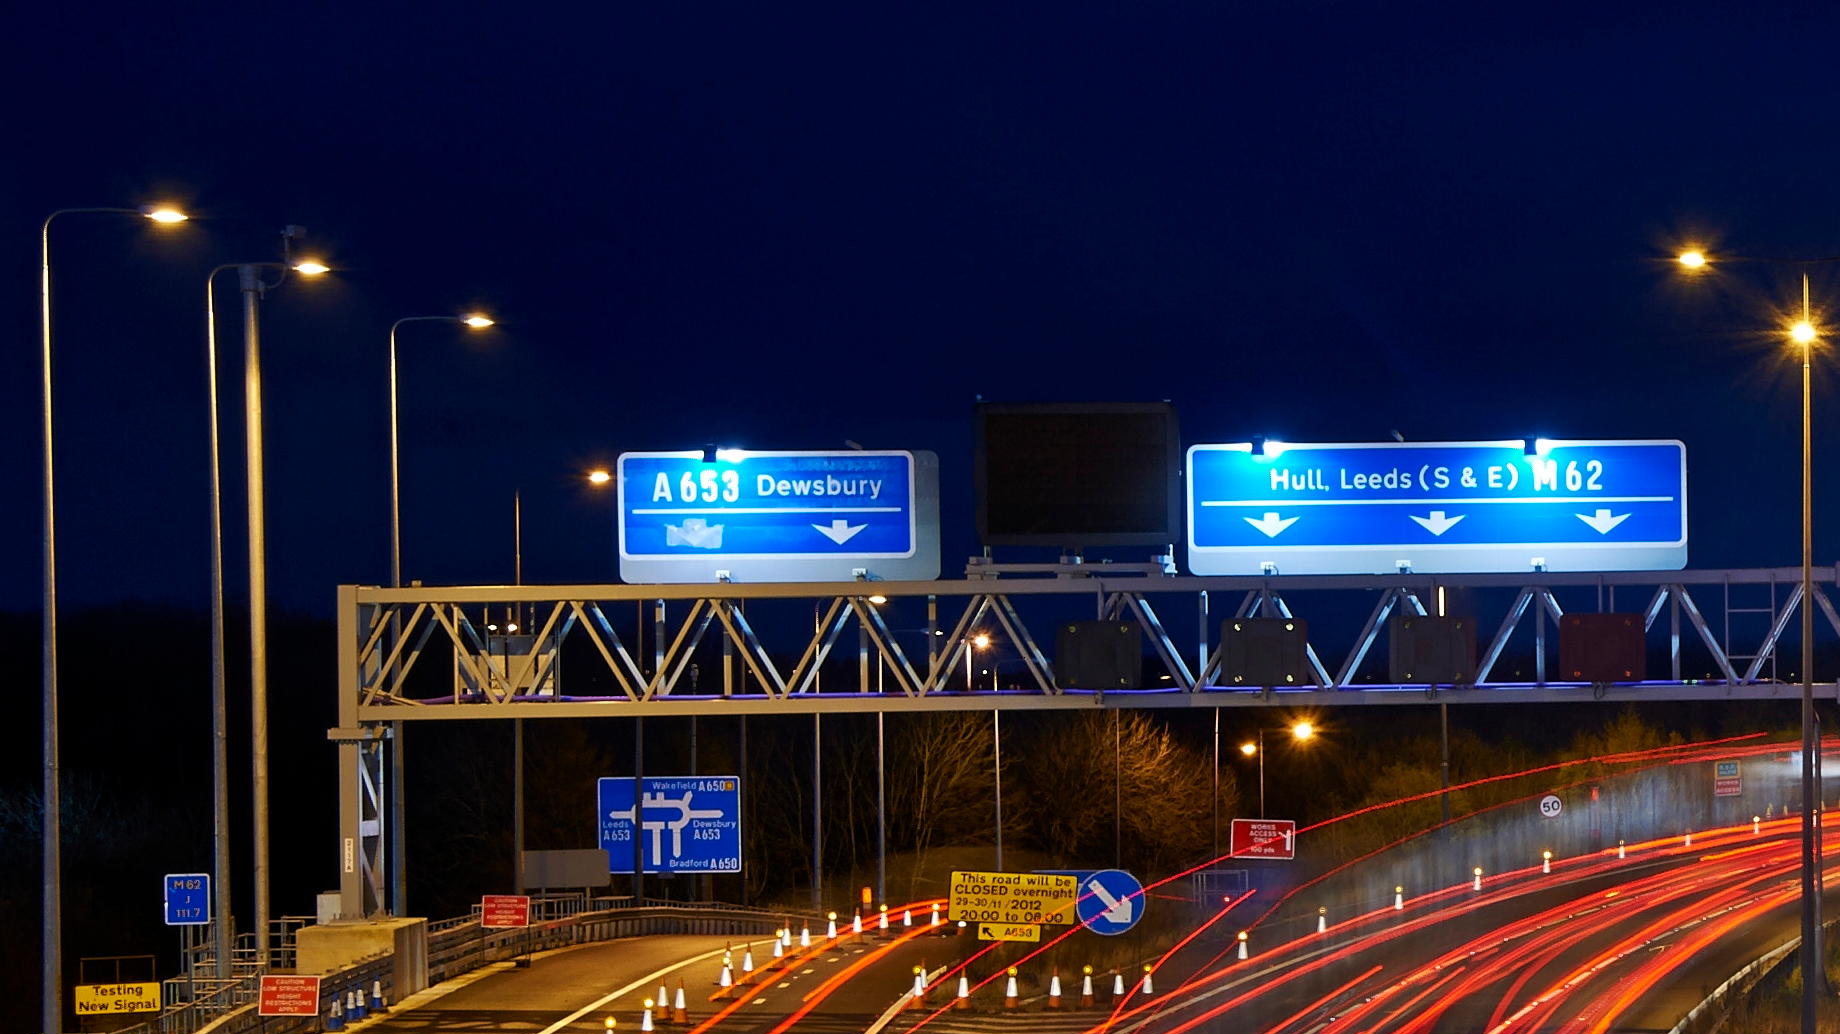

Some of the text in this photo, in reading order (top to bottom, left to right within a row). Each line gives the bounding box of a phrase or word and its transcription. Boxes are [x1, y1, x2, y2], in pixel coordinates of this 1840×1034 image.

[1270, 467, 1330, 492] Hull,
[1340, 467, 1412, 490] Leeds
[1418, 464, 1450, 492] (S
[1460, 467, 1478, 489] &
[1488, 464, 1519, 491] E)
[756, 474, 882, 499] Dewsbury
[652, 781, 696, 790] Wakefield
[1542, 800, 1560, 813] 50
[603, 820, 629, 828] Leeds
[693, 820, 737, 829] Dewsbury
[669, 859, 708, 868] Bradford
[961, 873, 1071, 887] This road will be
[955, 884, 1073, 900] CLOSED overnight
[1006, 912, 1018, 921] to
[1004, 927, 1033, 938] A653
[92, 985, 143, 996] Testing
[79, 998, 156, 1012] New Signal
